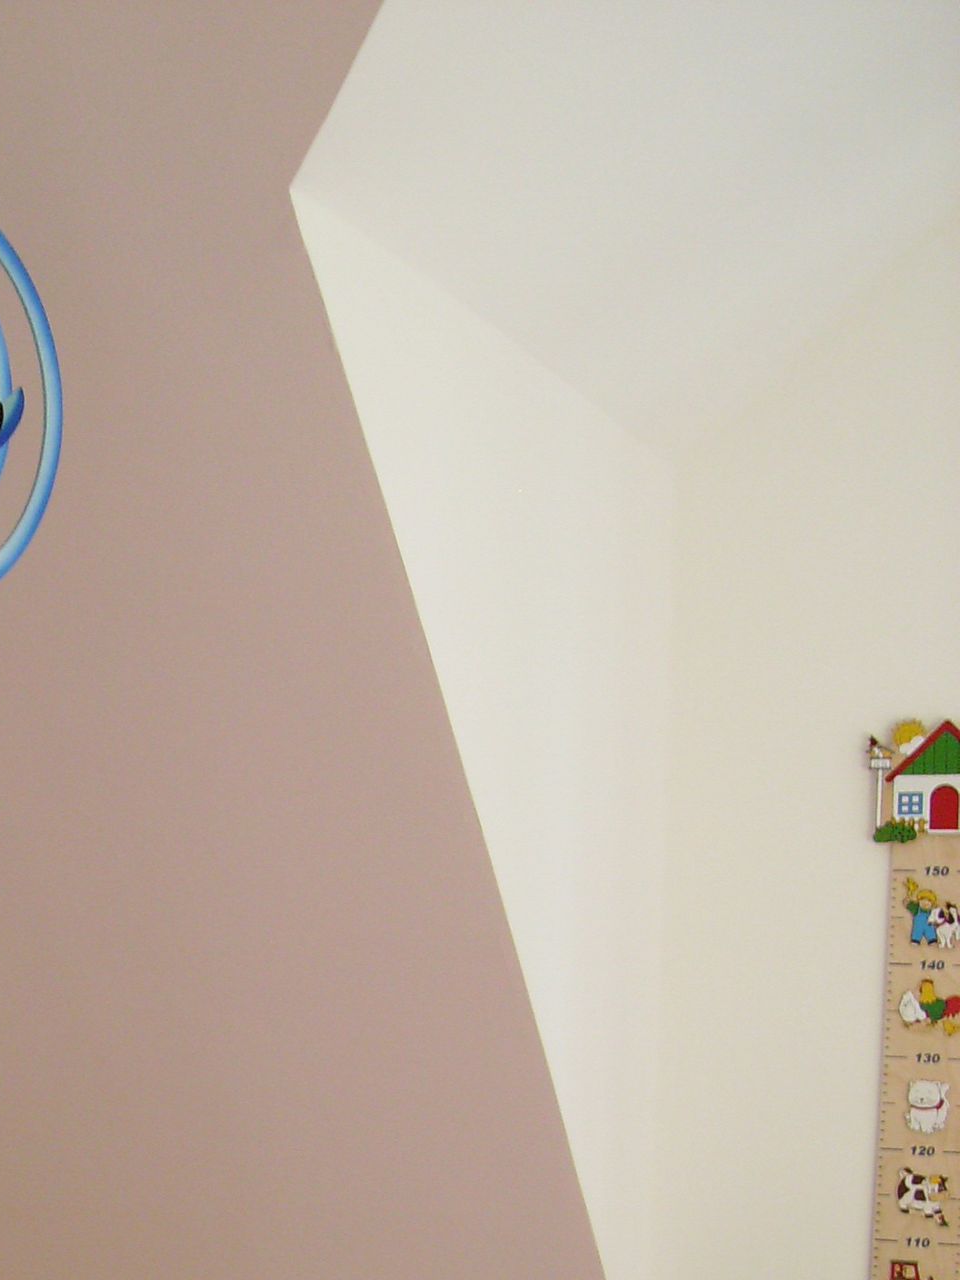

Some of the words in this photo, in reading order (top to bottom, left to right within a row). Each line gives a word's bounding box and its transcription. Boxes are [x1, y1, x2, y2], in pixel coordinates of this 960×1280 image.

[925, 866, 950, 876] 150
[920, 960, 945, 970] 140
[916, 1053, 941, 1063] 130
[911, 1146, 936, 1156] 120
[906, 1237, 930, 1248] 110
